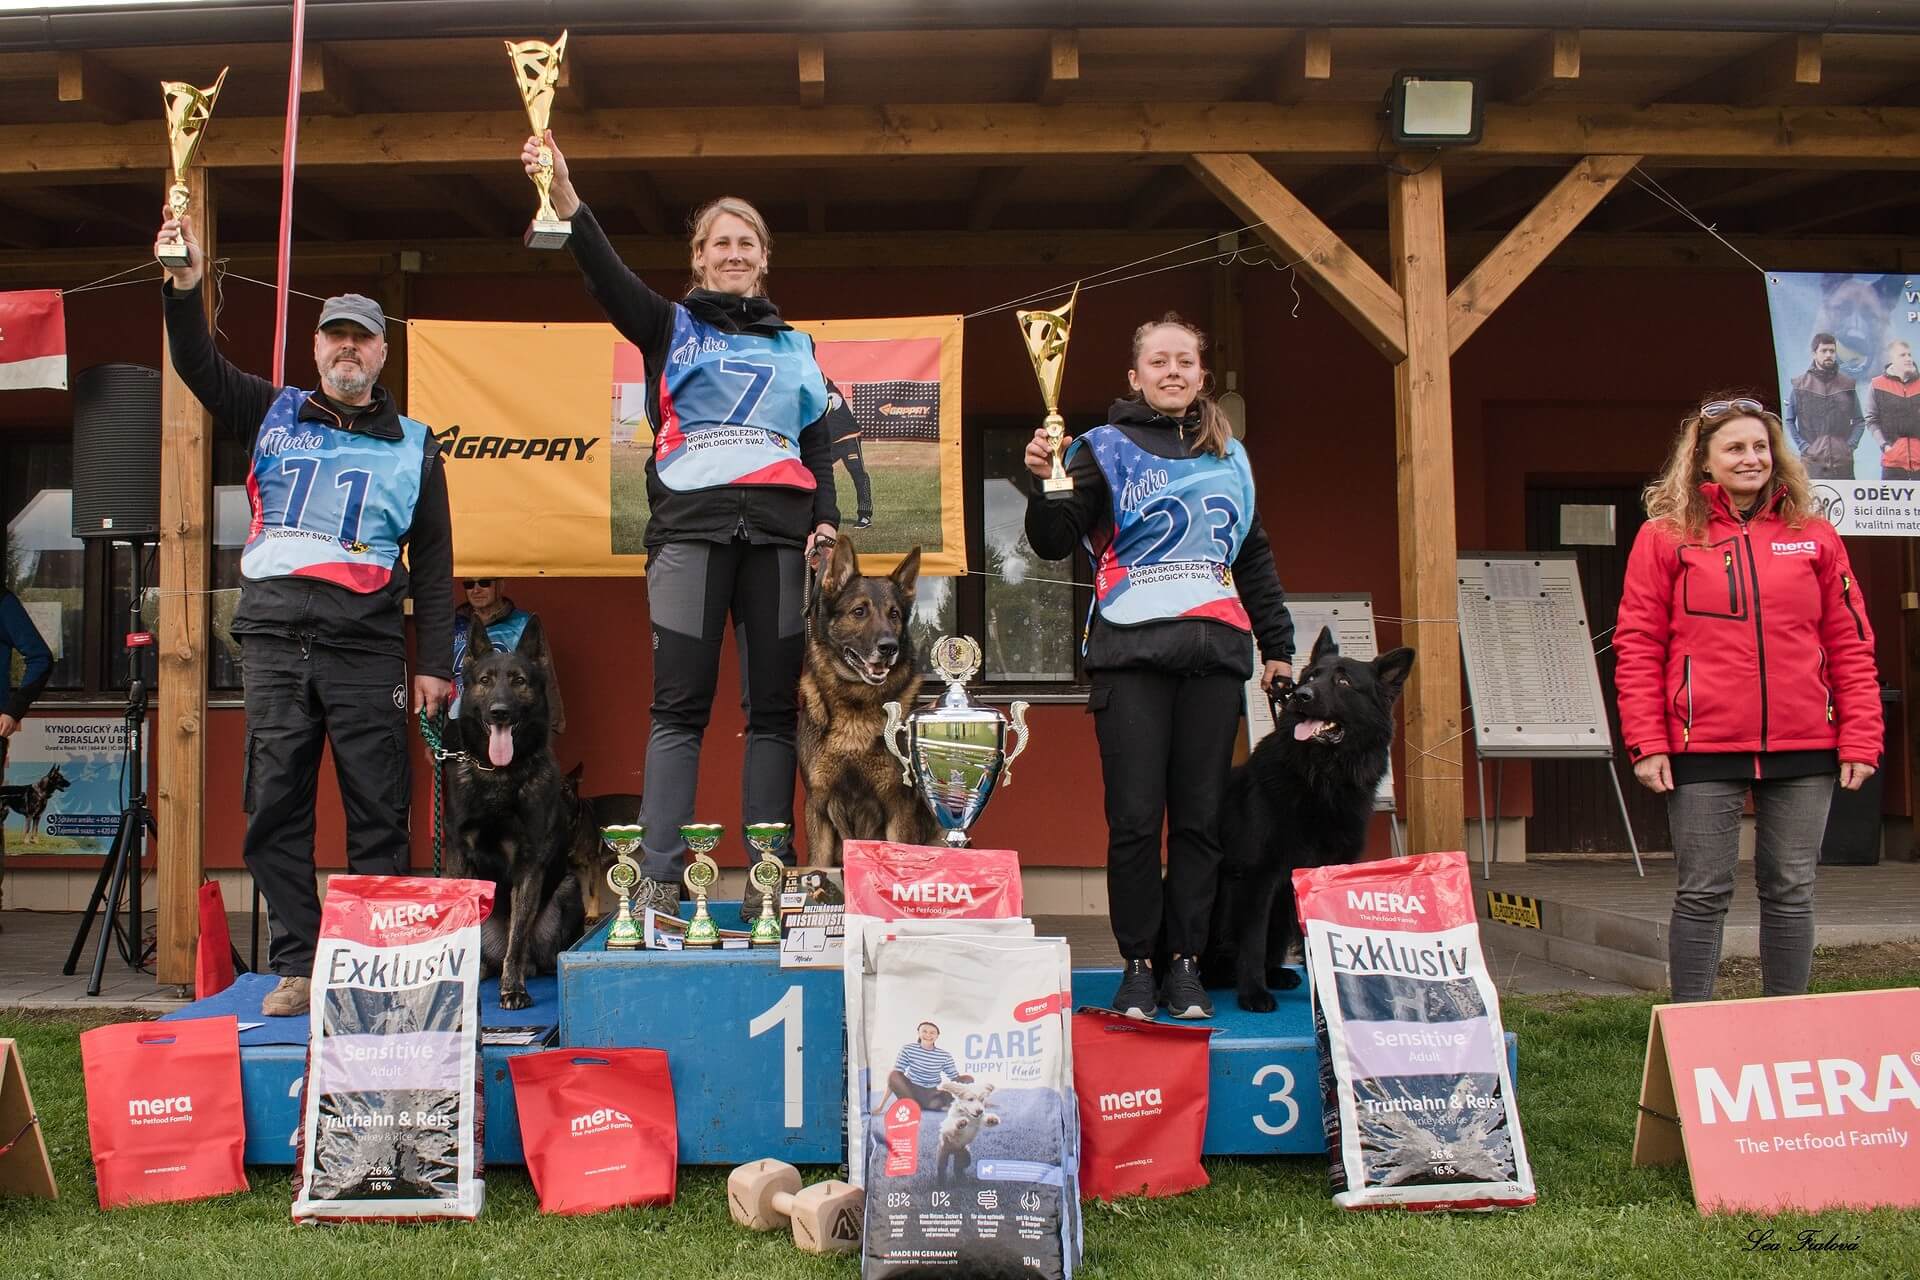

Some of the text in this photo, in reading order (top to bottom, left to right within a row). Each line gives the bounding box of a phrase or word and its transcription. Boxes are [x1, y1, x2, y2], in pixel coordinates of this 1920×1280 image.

[720, 358, 776, 426] 7
[454, 436, 600, 461] GAPPAY
[745, 438, 765, 446] SVAZ
[281, 457, 373, 544] 11
[312, 531, 333, 543] SVAZ
[1130, 494, 1240, 568] 23
[1771, 541, 1816, 551] mera
[1191, 572, 1211, 580] SVAZ
[58, 735, 106, 744] ZBRASLAV
[108, 735, 115, 744] U
[892, 883, 975, 904] MERA
[1346, 890, 1427, 914] MERA
[369, 903, 440, 931] MERA
[1327, 930, 1468, 977] Exklusiv
[328, 943, 466, 988] Exklusiv
[964, 1024, 1043, 1060] CARE
[1374, 1029, 1466, 1047] Sensitive
[342, 1042, 433, 1062] Sensitive
[749, 985, 803, 1129] 1
[1408, 1050, 1440, 1062] Adult
[370, 1065, 401, 1077] Adult
[964, 1060, 1004, 1073] PUPPY
[1694, 1054, 1920, 1125] MERA
[129, 1096, 193, 1116] mera
[1100, 1088, 1162, 1112] mera
[1251, 1064, 1299, 1135] 3
[1365, 1093, 1498, 1114] Truthahn & Reis
[143, 1117, 169, 1125] Petfood
[170, 1114, 192, 1122] Family
[325, 1111, 451, 1130] Truthahn & Reis
[571, 1108, 632, 1132] mera
[1102, 1113, 1113, 1121] The
[1114, 1110, 1140, 1120] Petfood
[1735, 1126, 1908, 1154] The Petfood Family
[1430, 1150, 1454, 1160] 26%
[370, 1166, 393, 1176] 26%
[1432, 1165, 1455, 1176] 16%
[370, 1181, 392, 1191] 16%
[887, 1191, 911, 1208] 83%
[931, 1191, 951, 1208] 0%
[890, 1250, 911, 1258] MADE
[1023, 1256, 1031, 1266] 10
